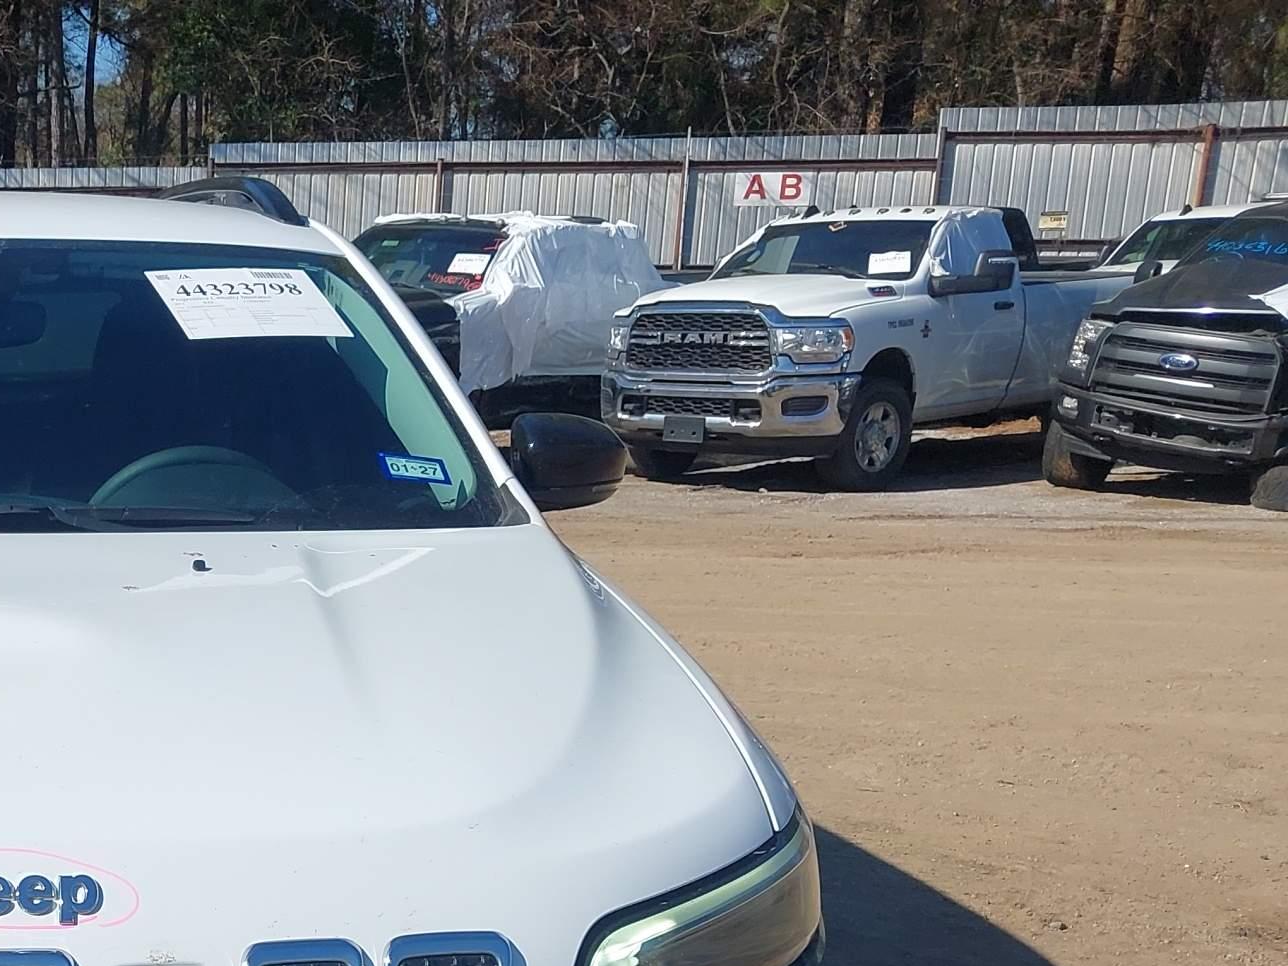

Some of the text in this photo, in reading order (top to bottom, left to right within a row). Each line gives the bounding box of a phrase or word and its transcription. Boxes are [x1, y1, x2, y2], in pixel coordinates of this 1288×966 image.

[743, 174, 802, 200] A B
[176, 282, 303, 297] 44323798
[663, 332, 724, 344] RAM
